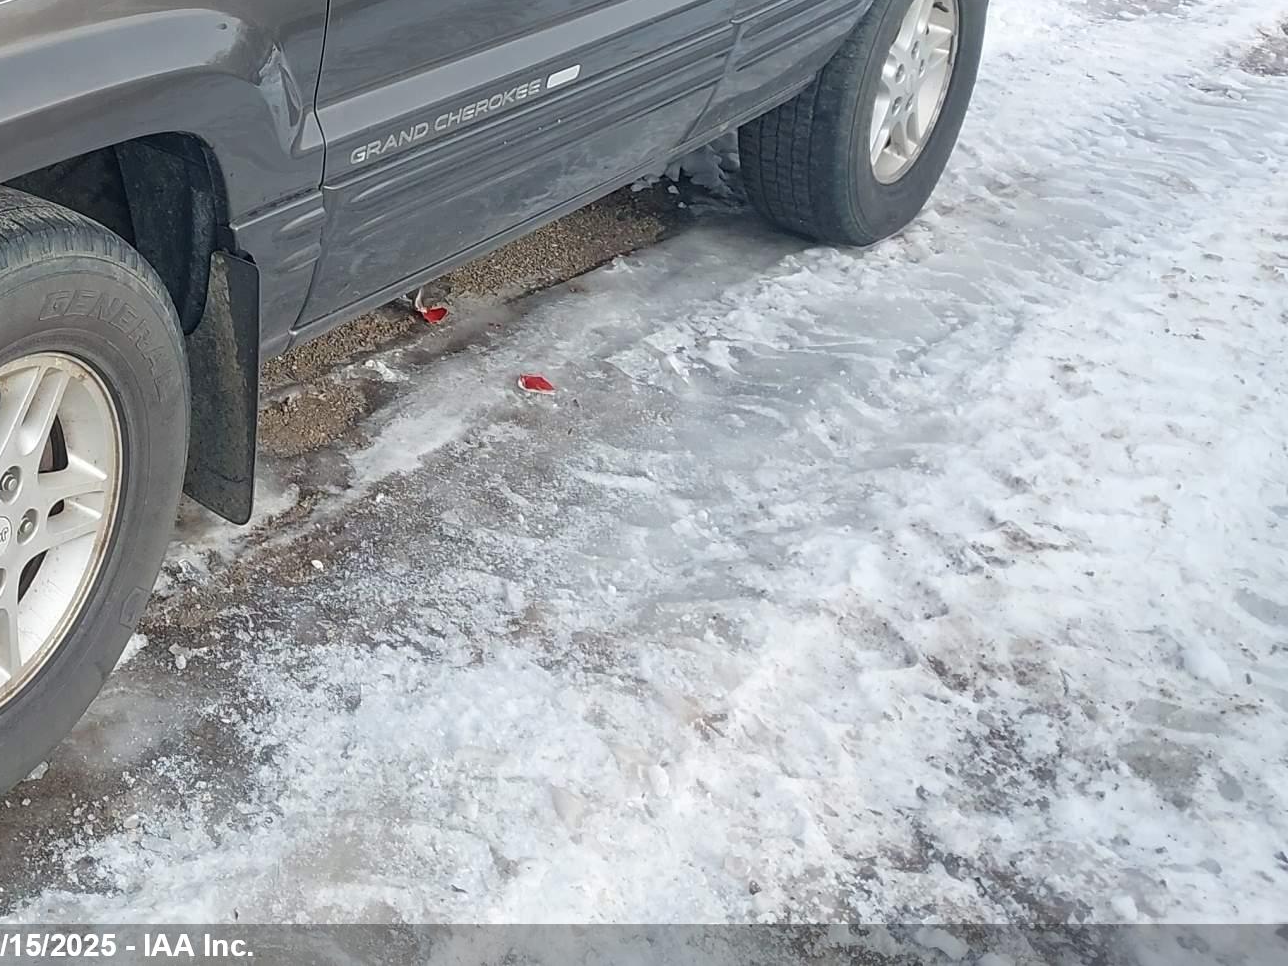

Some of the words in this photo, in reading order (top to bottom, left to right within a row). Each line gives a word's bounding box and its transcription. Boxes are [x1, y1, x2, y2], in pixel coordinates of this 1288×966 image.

[350, 122, 429, 165] GRAND
[433, 77, 543, 132] CHEROKEE
[38, 289, 171, 402] GENERAL
